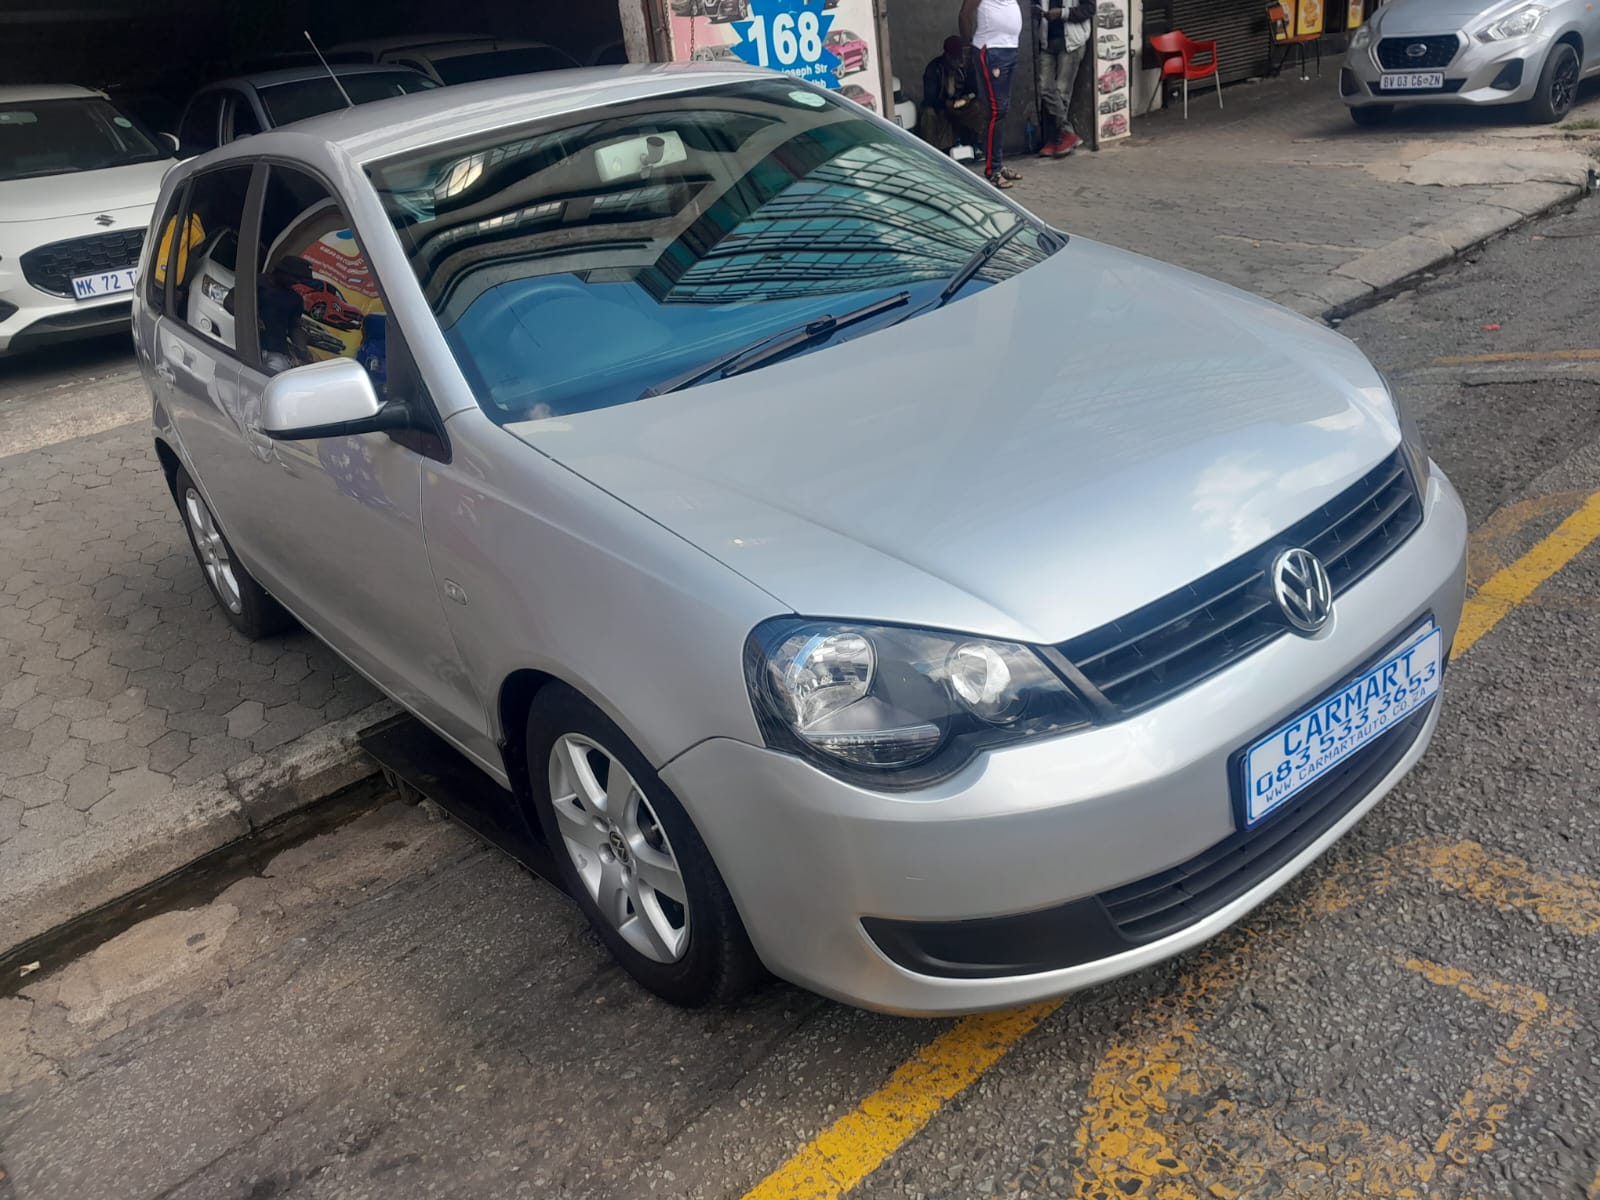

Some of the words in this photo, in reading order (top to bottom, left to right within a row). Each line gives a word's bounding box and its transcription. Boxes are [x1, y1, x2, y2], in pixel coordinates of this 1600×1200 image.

[747, 11, 822, 67] 168
[815, 64, 828, 74] Str
[1428, 74, 1441, 86] ZN
[75, 278, 96, 296] MK
[101, 274, 121, 291] 72
[126, 270, 137, 288] T
[1284, 649, 1416, 757] CARMART
[1256, 746, 1311, 797] 083
[1319, 707, 1369, 754] 533
[1377, 660, 1436, 714] 3653
